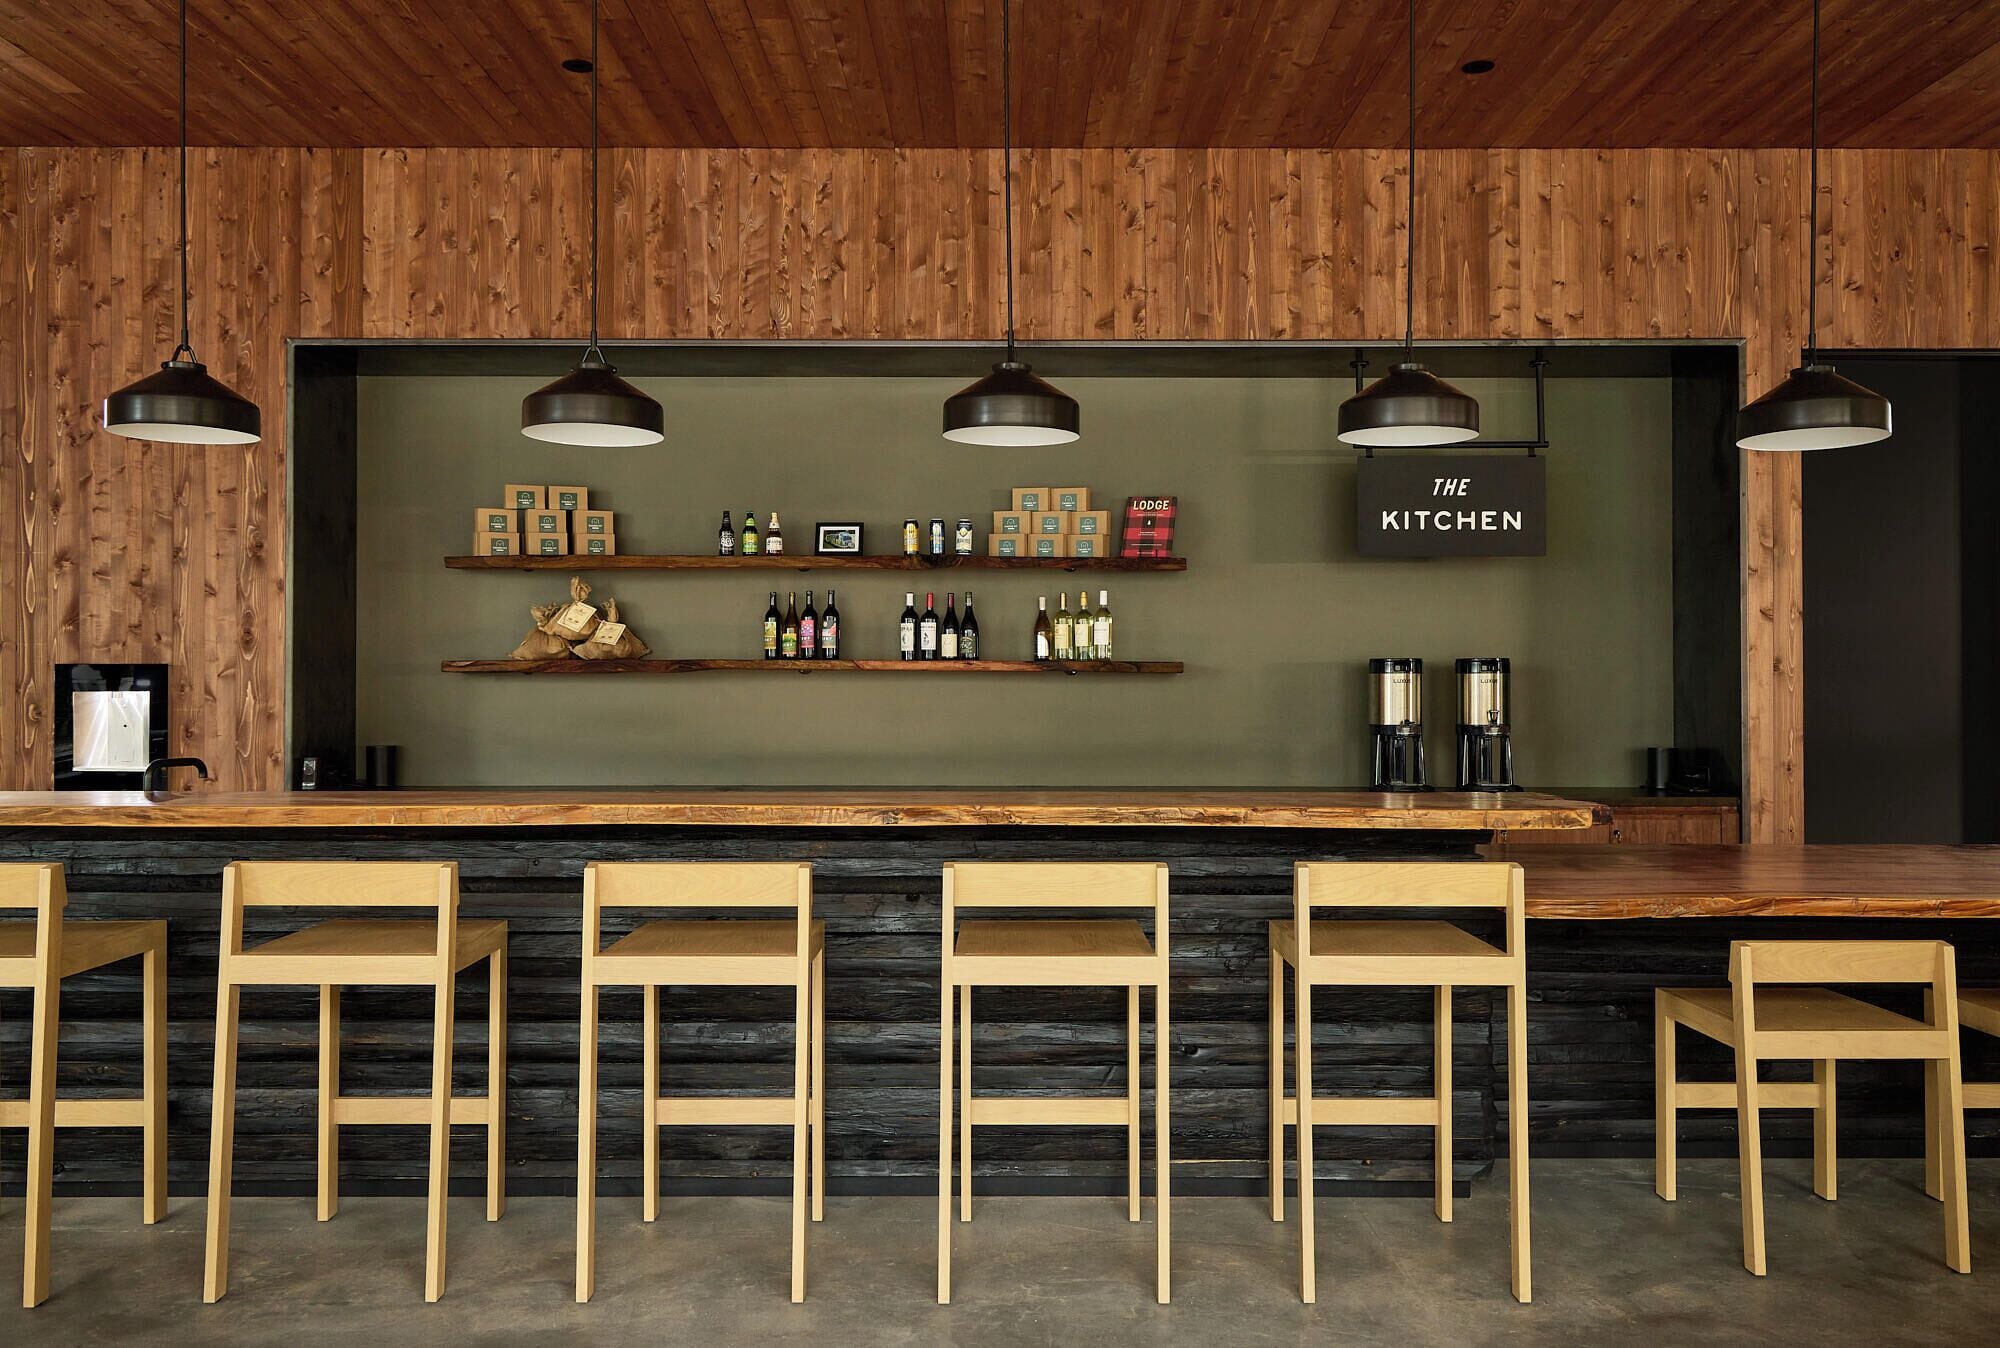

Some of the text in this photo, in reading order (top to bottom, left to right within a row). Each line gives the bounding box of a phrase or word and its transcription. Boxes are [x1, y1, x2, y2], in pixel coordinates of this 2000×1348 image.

[1432, 478, 1471, 497] THE
[1132, 499, 1170, 511] LODGE
[1382, 510, 1522, 531] KITCHEN
